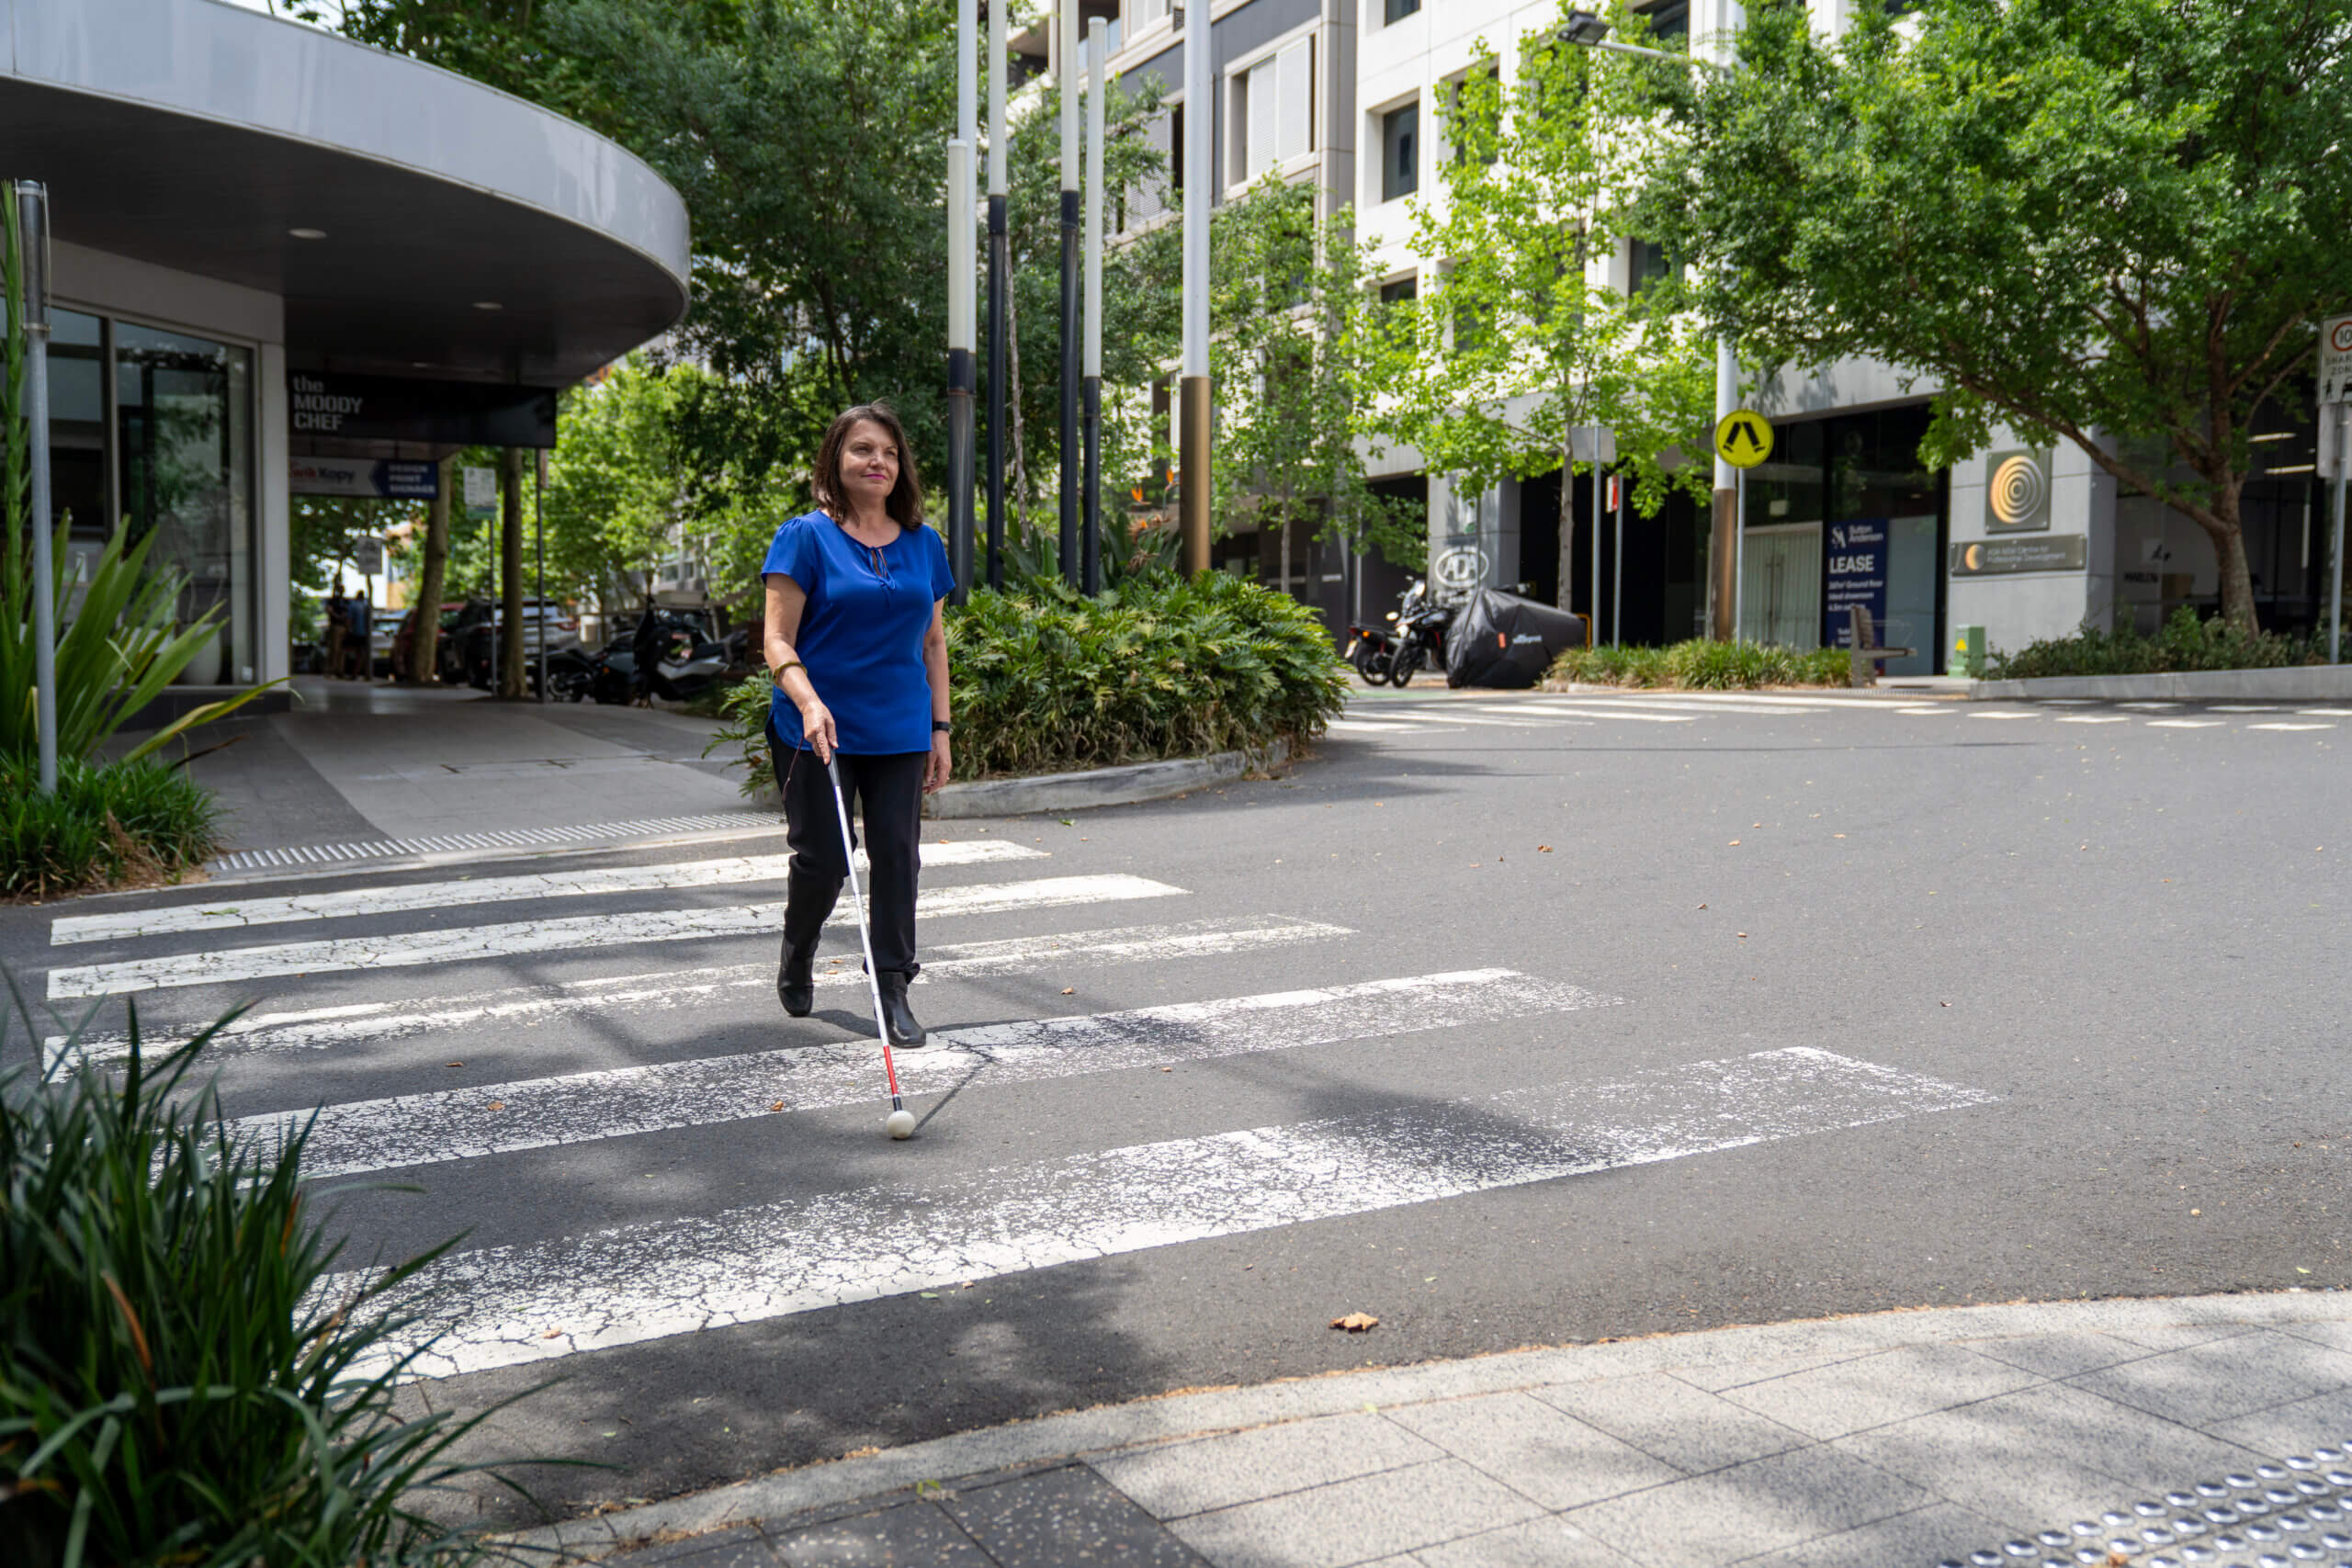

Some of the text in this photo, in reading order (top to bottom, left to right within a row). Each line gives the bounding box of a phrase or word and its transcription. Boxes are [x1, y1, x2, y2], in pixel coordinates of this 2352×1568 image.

[293, 375, 324, 393] the
[294, 394, 364, 414] MOODY
[294, 412, 344, 431] CHEF
[1443, 554, 1478, 580] ADA
[1829, 555, 1875, 574] LEASE
